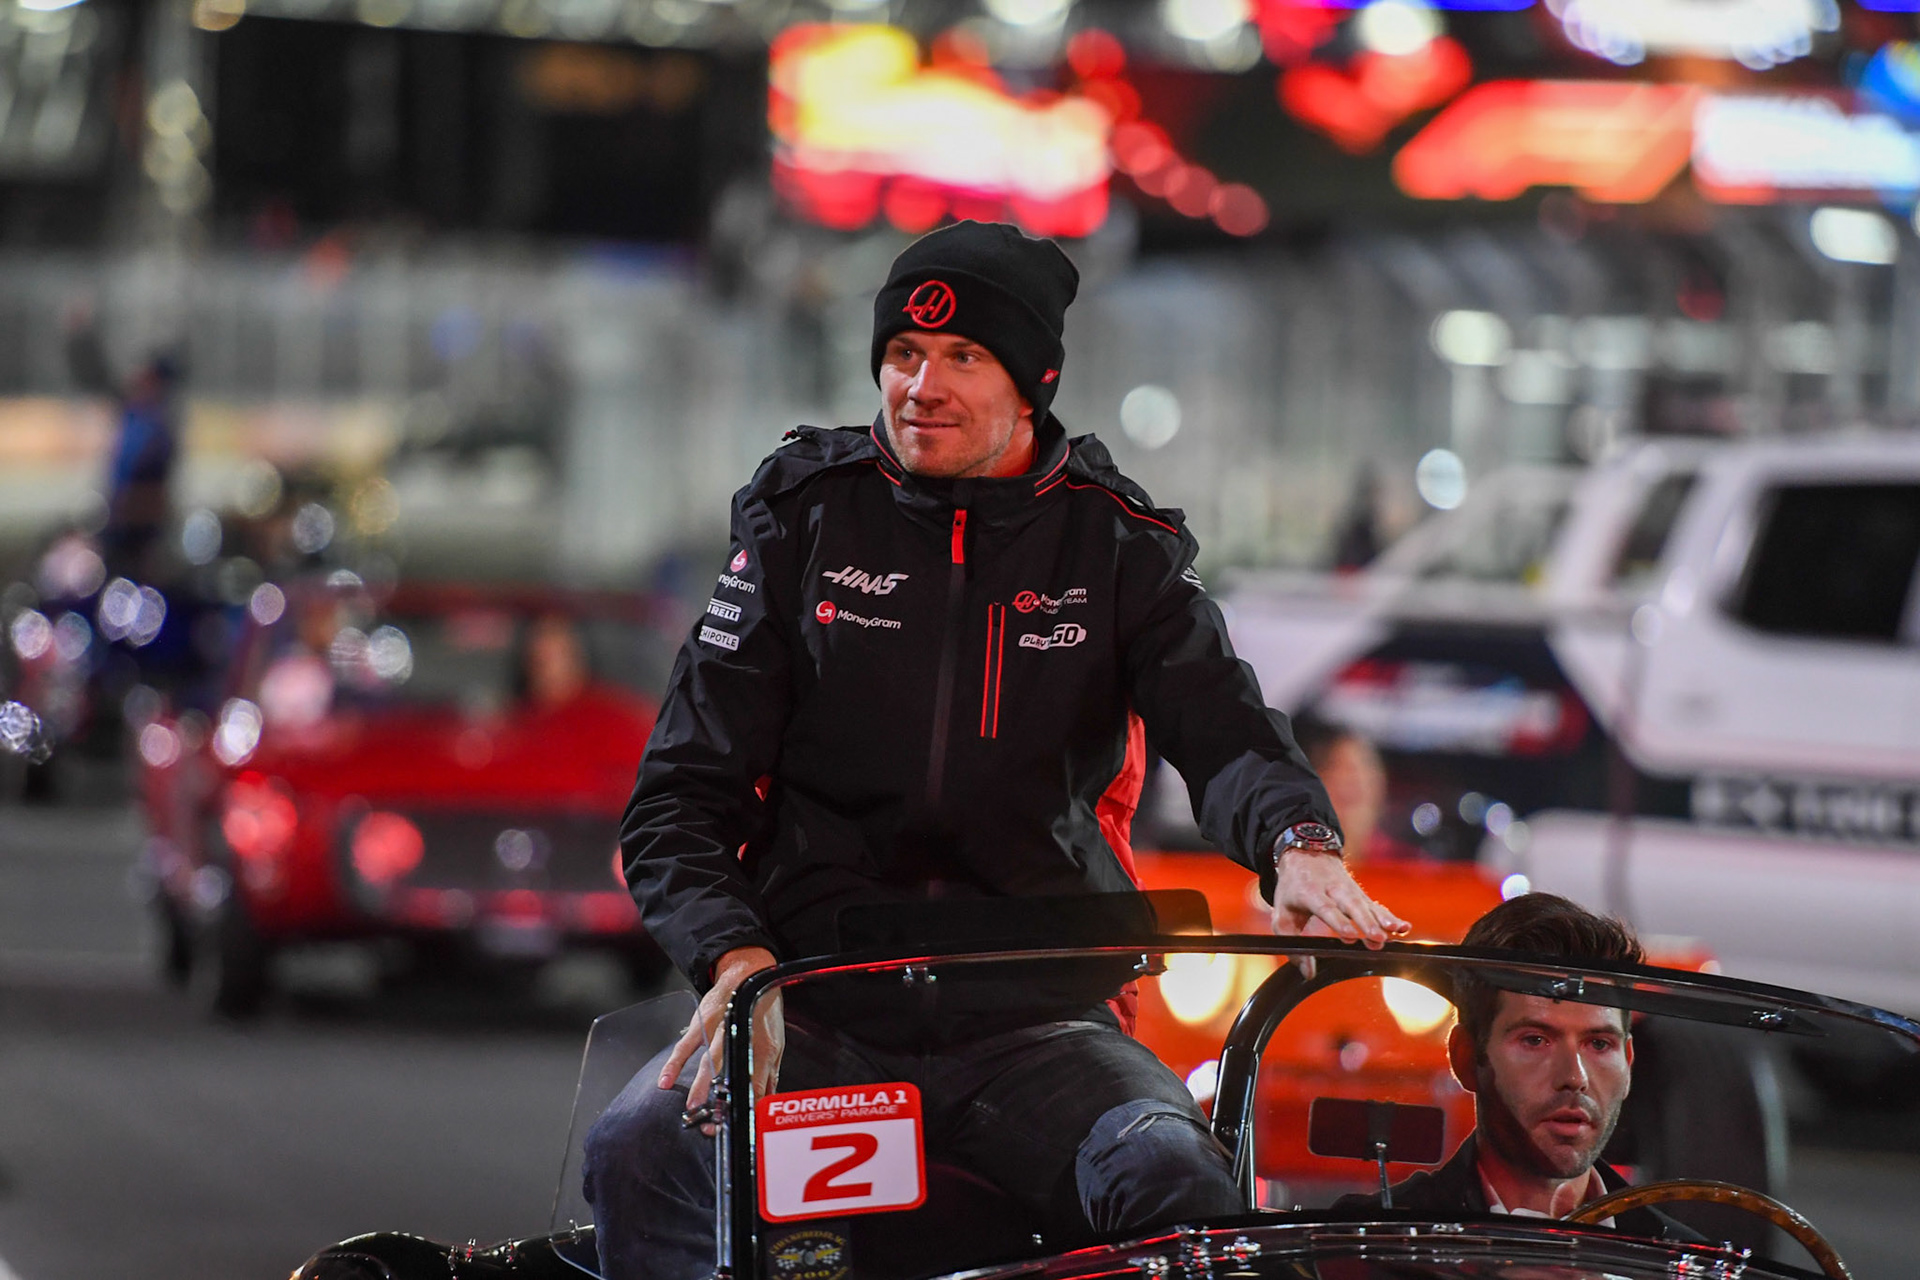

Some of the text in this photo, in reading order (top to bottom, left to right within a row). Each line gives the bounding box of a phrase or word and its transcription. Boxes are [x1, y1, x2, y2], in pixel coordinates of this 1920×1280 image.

[718, 573, 755, 594] neyGram
[822, 565, 909, 595] HAAS
[836, 609, 902, 630] MoneyGram
[768, 1090, 908, 1116] FORMULA 1
[775, 1104, 898, 1126] DRIVERS' PARADE
[802, 1132, 879, 1203] 2
